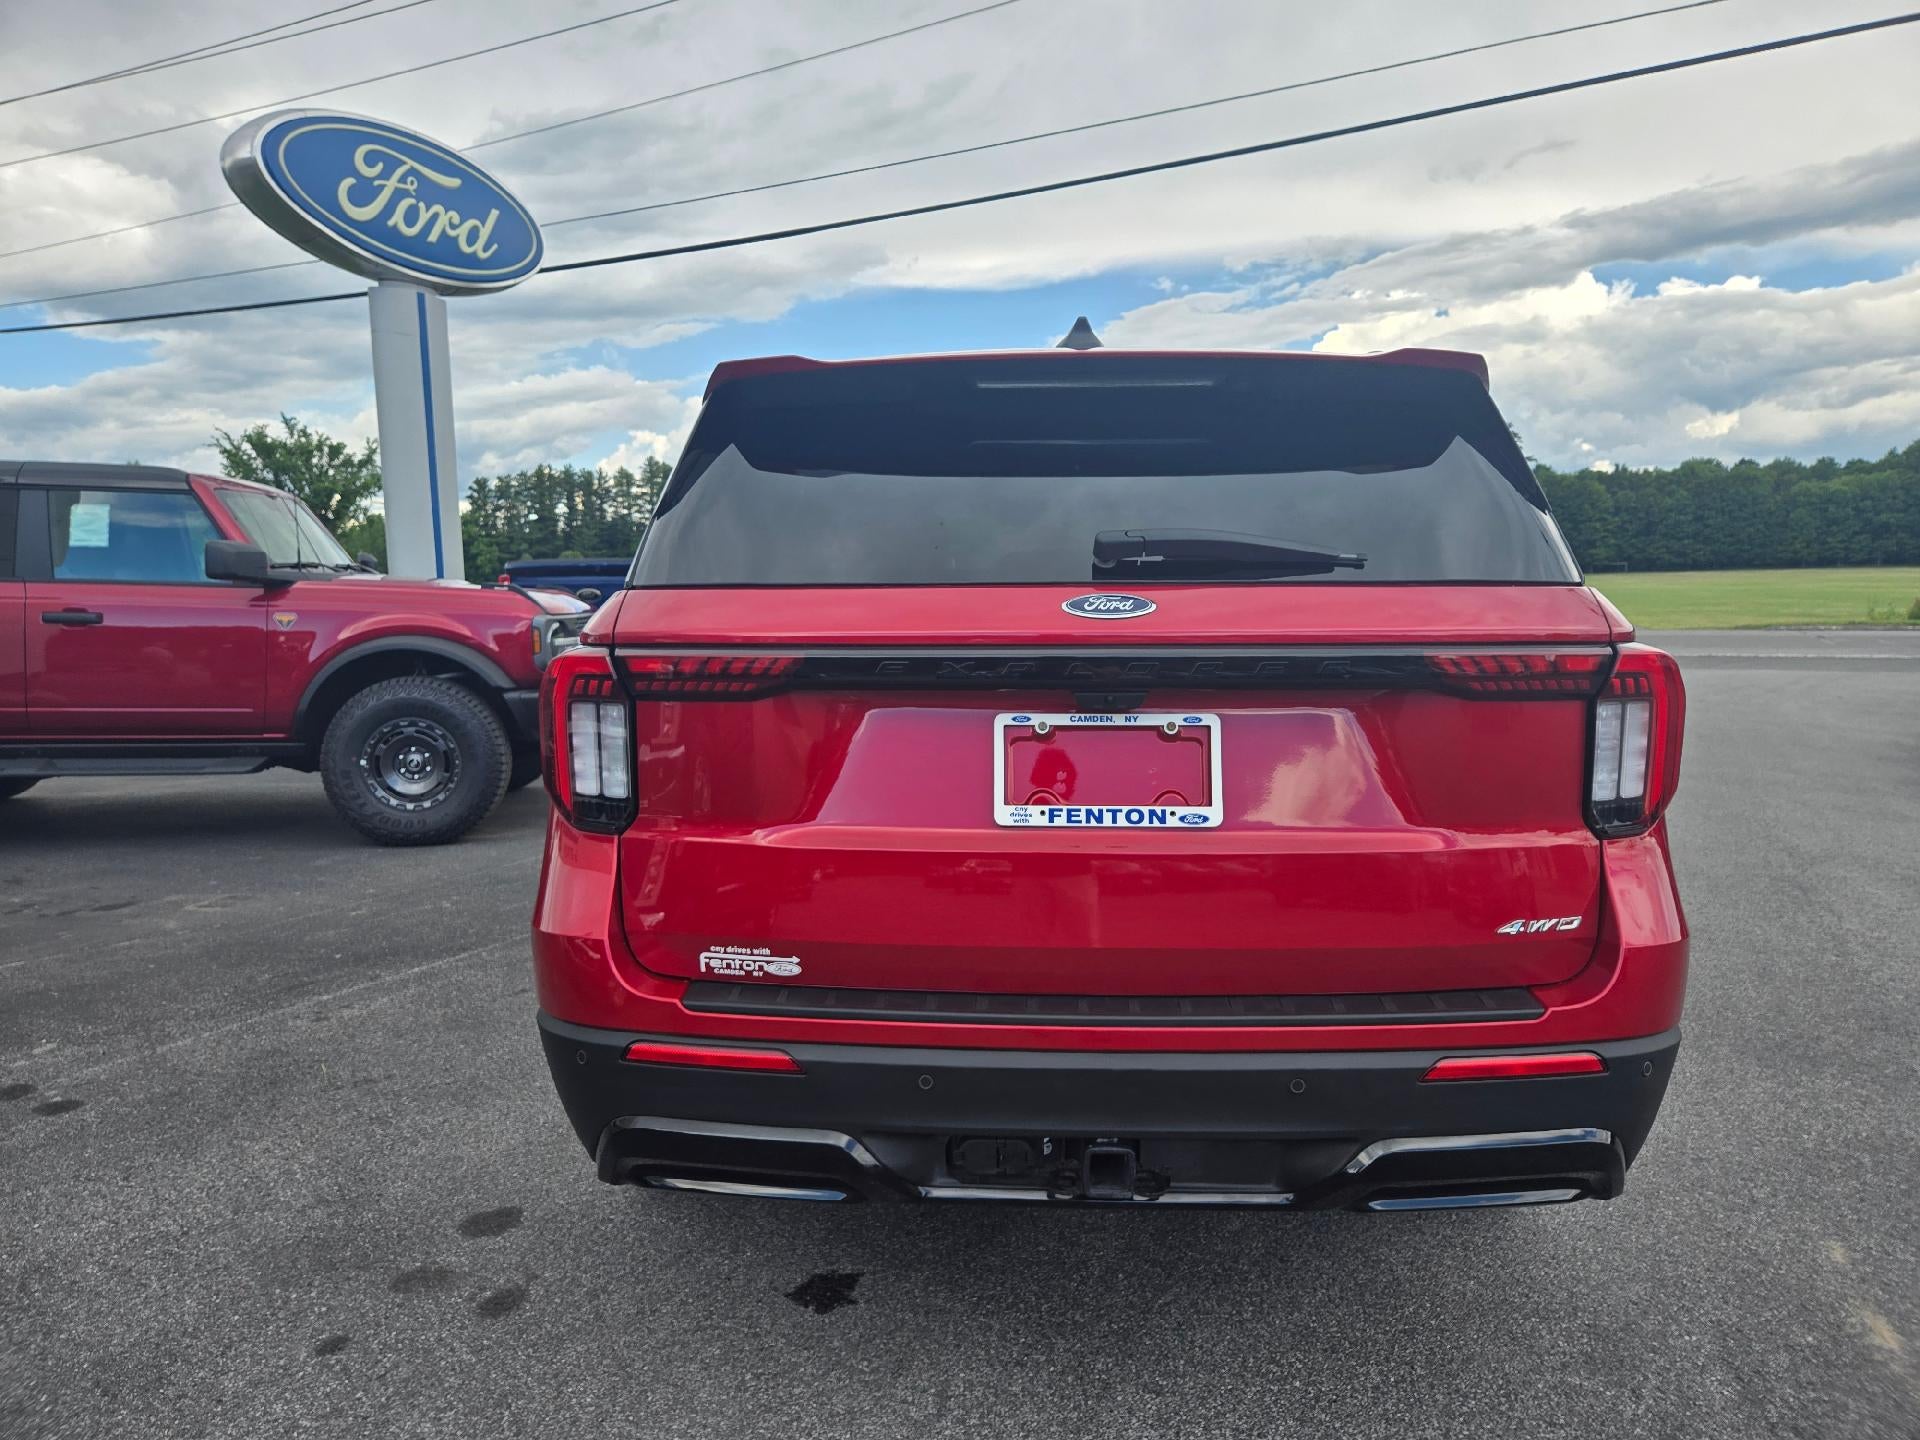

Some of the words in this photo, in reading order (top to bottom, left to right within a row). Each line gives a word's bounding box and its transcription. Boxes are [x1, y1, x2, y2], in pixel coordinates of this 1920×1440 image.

[337, 143, 499, 260] Ford
[1083, 596, 1134, 611] Ford
[874, 660, 1352, 678] EXPLORER
[1070, 715, 1115, 724] CAMDEN,
[1125, 715, 1139, 723] NY
[1048, 807, 1167, 825] FENTON
[1496, 915, 1582, 935] 4WD
[726, 946, 751, 954] drives
